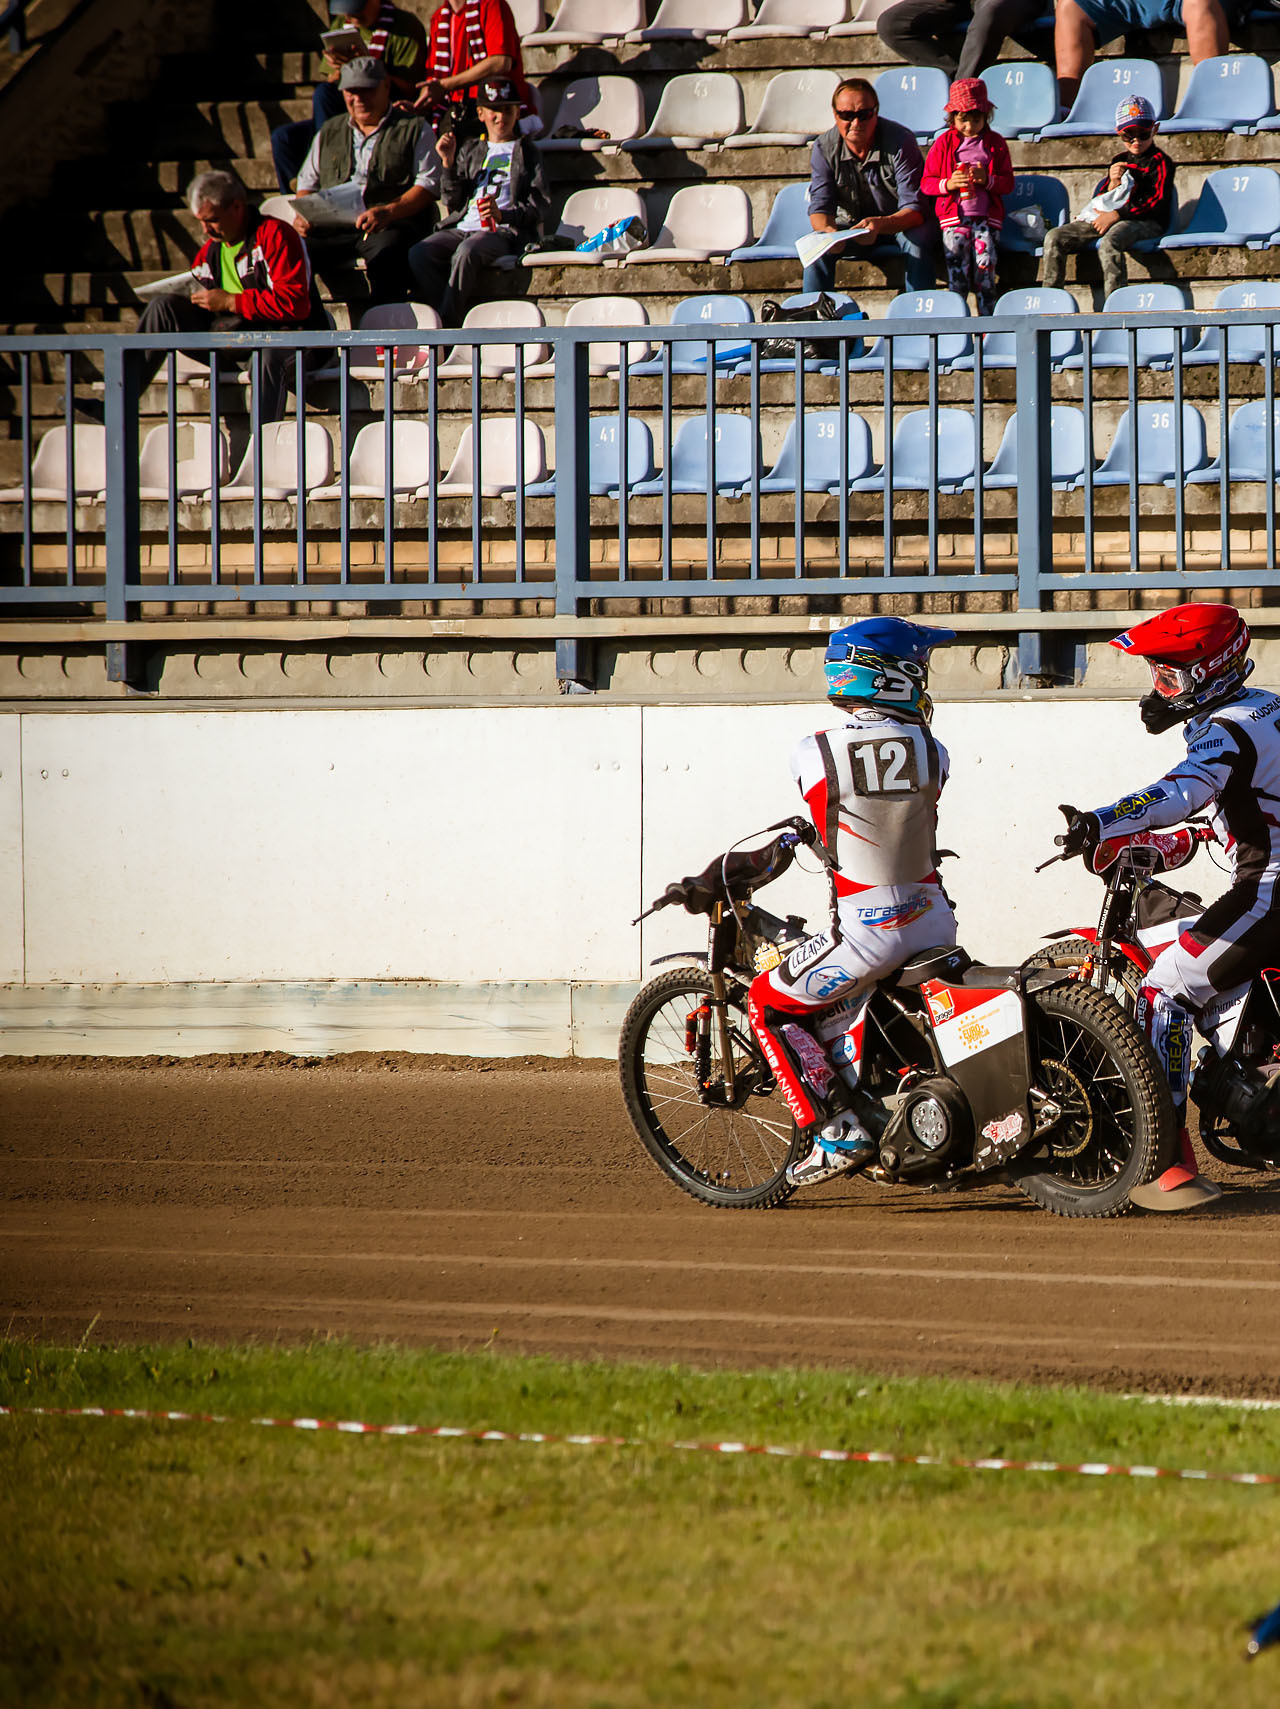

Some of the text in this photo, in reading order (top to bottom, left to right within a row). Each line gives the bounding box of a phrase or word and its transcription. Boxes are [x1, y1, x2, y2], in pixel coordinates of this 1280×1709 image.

[1112, 68, 1132, 85] 39
[1220, 61, 1241, 78] 38
[900, 74, 917, 91] 41
[1004, 70, 1024, 86] 40
[1232, 176, 1249, 192] 37
[915, 298, 934, 313] 39
[1024, 295, 1041, 310] 38
[1136, 292, 1155, 309] 37
[1241, 293, 1257, 308] 36
[700, 302, 712, 319] 41
[1152, 413, 1169, 429] 36
[600, 427, 615, 442] 41
[817, 423, 834, 438] 39
[855, 741, 912, 792] 12
[1113, 791, 1157, 820] REALL
[962, 1024, 981, 1040] EURO
[1169, 1020, 1185, 1072] REALL
